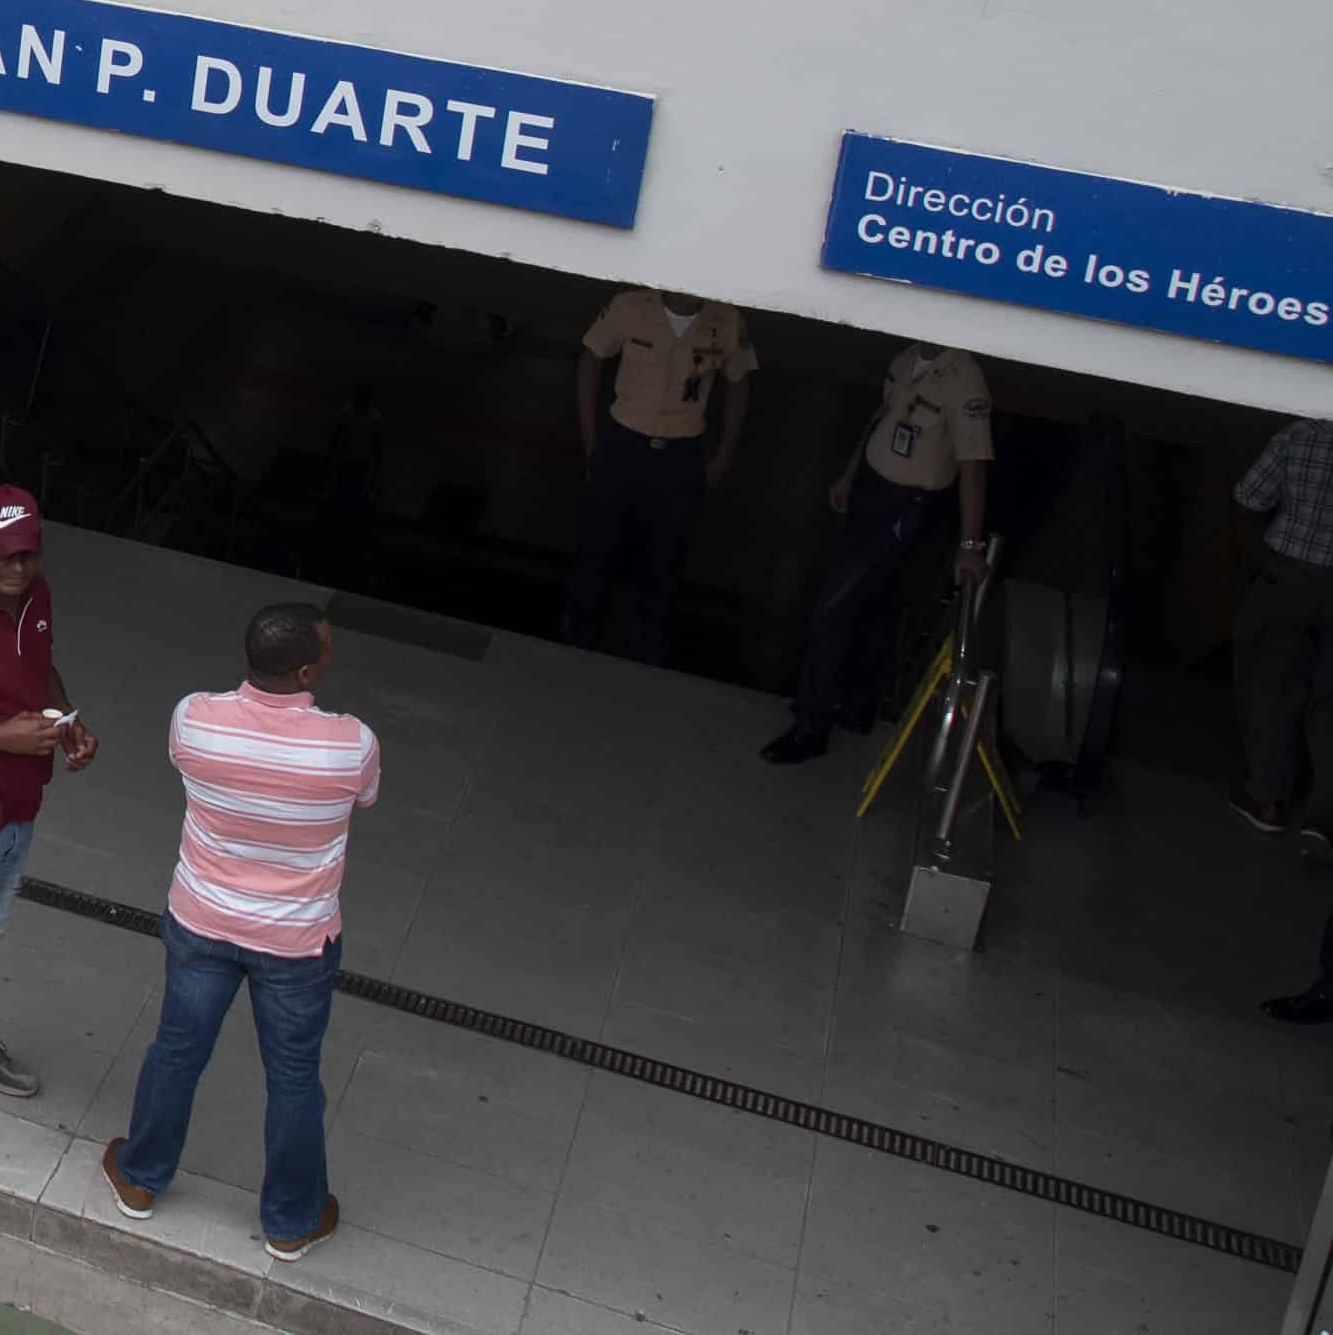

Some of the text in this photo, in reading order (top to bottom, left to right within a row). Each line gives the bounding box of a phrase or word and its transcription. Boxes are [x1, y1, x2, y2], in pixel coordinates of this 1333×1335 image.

[96, 39, 157, 103] P.
[191, 55, 556, 176] DUARTE
[864, 169, 1056, 233] Dirección
[856, 213, 1330, 326] Centro de los Héroes
[0, 504, 26, 519] NIKE
